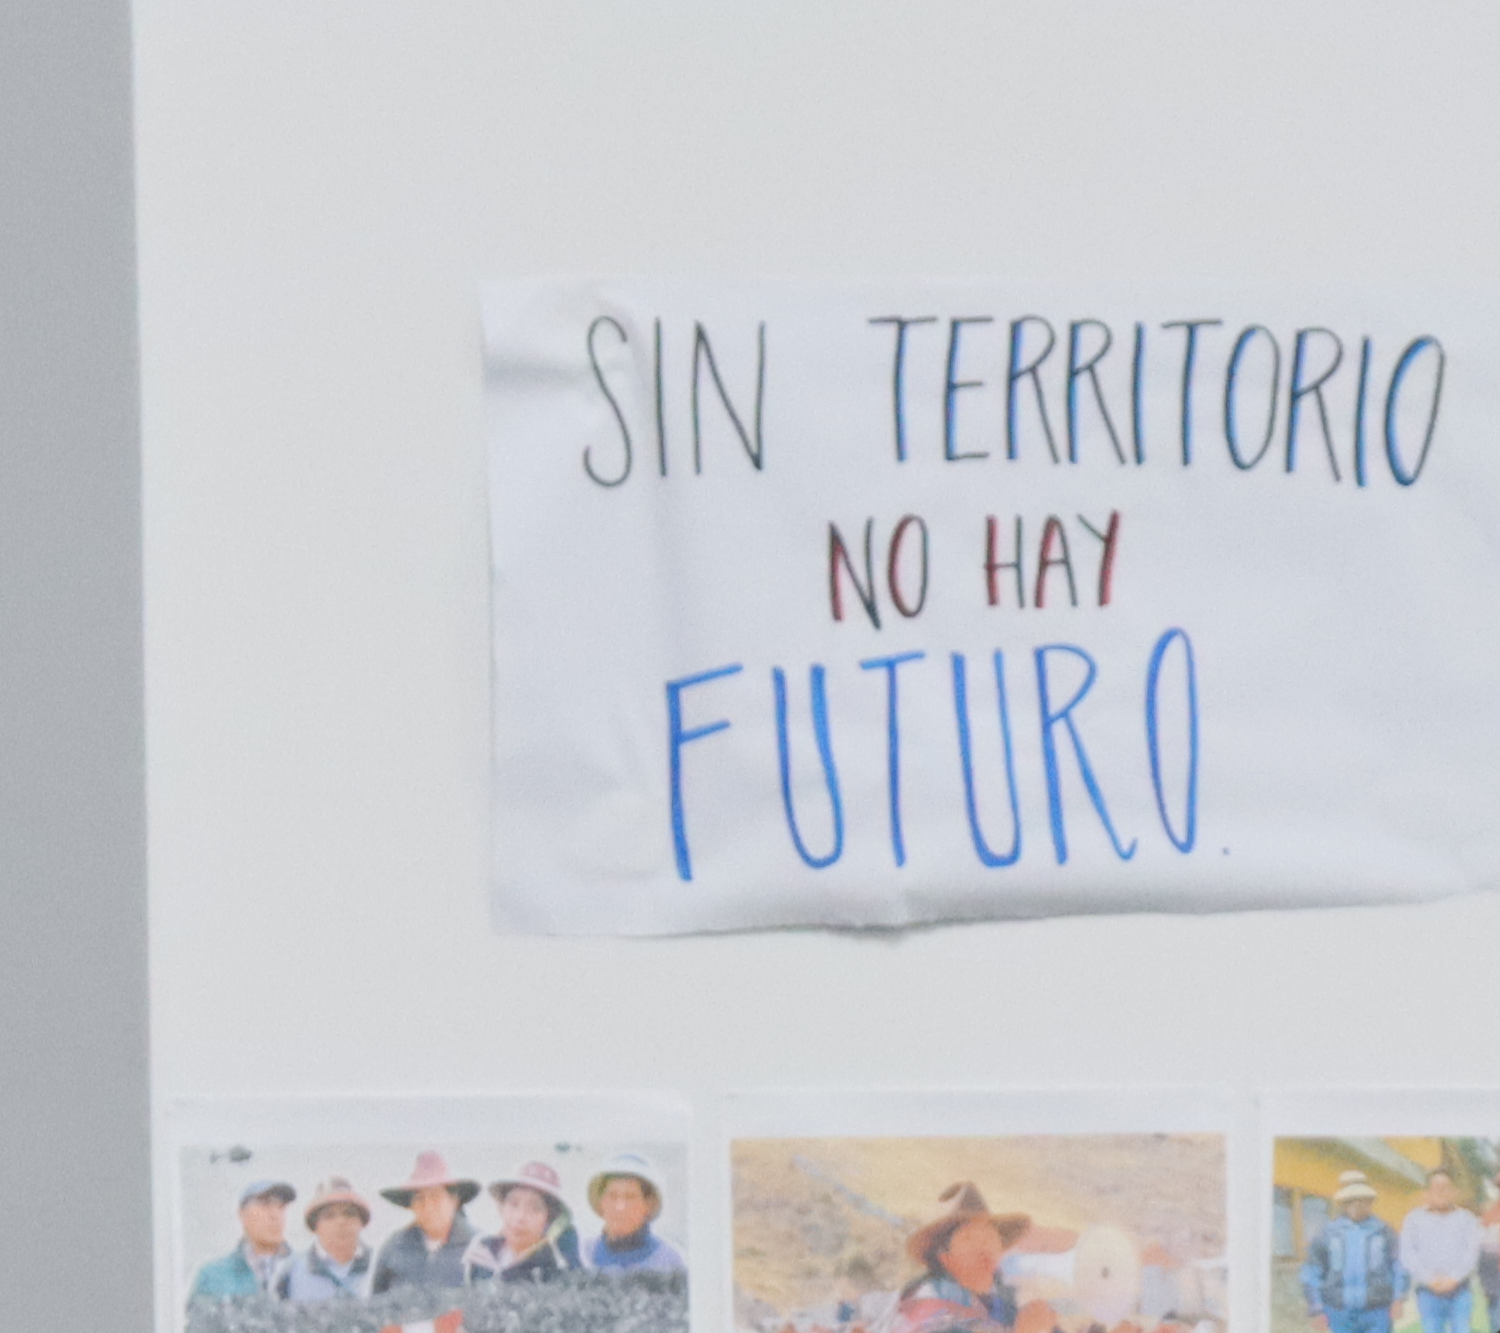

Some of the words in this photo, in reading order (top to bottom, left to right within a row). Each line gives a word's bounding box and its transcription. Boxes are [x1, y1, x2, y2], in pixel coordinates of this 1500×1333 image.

[580, 313, 766, 490] SIN
[866, 313, 1448, 490] TERRITORIO
[825, 511, 932, 632] NO
[980, 507, 1123, 610] HAY
